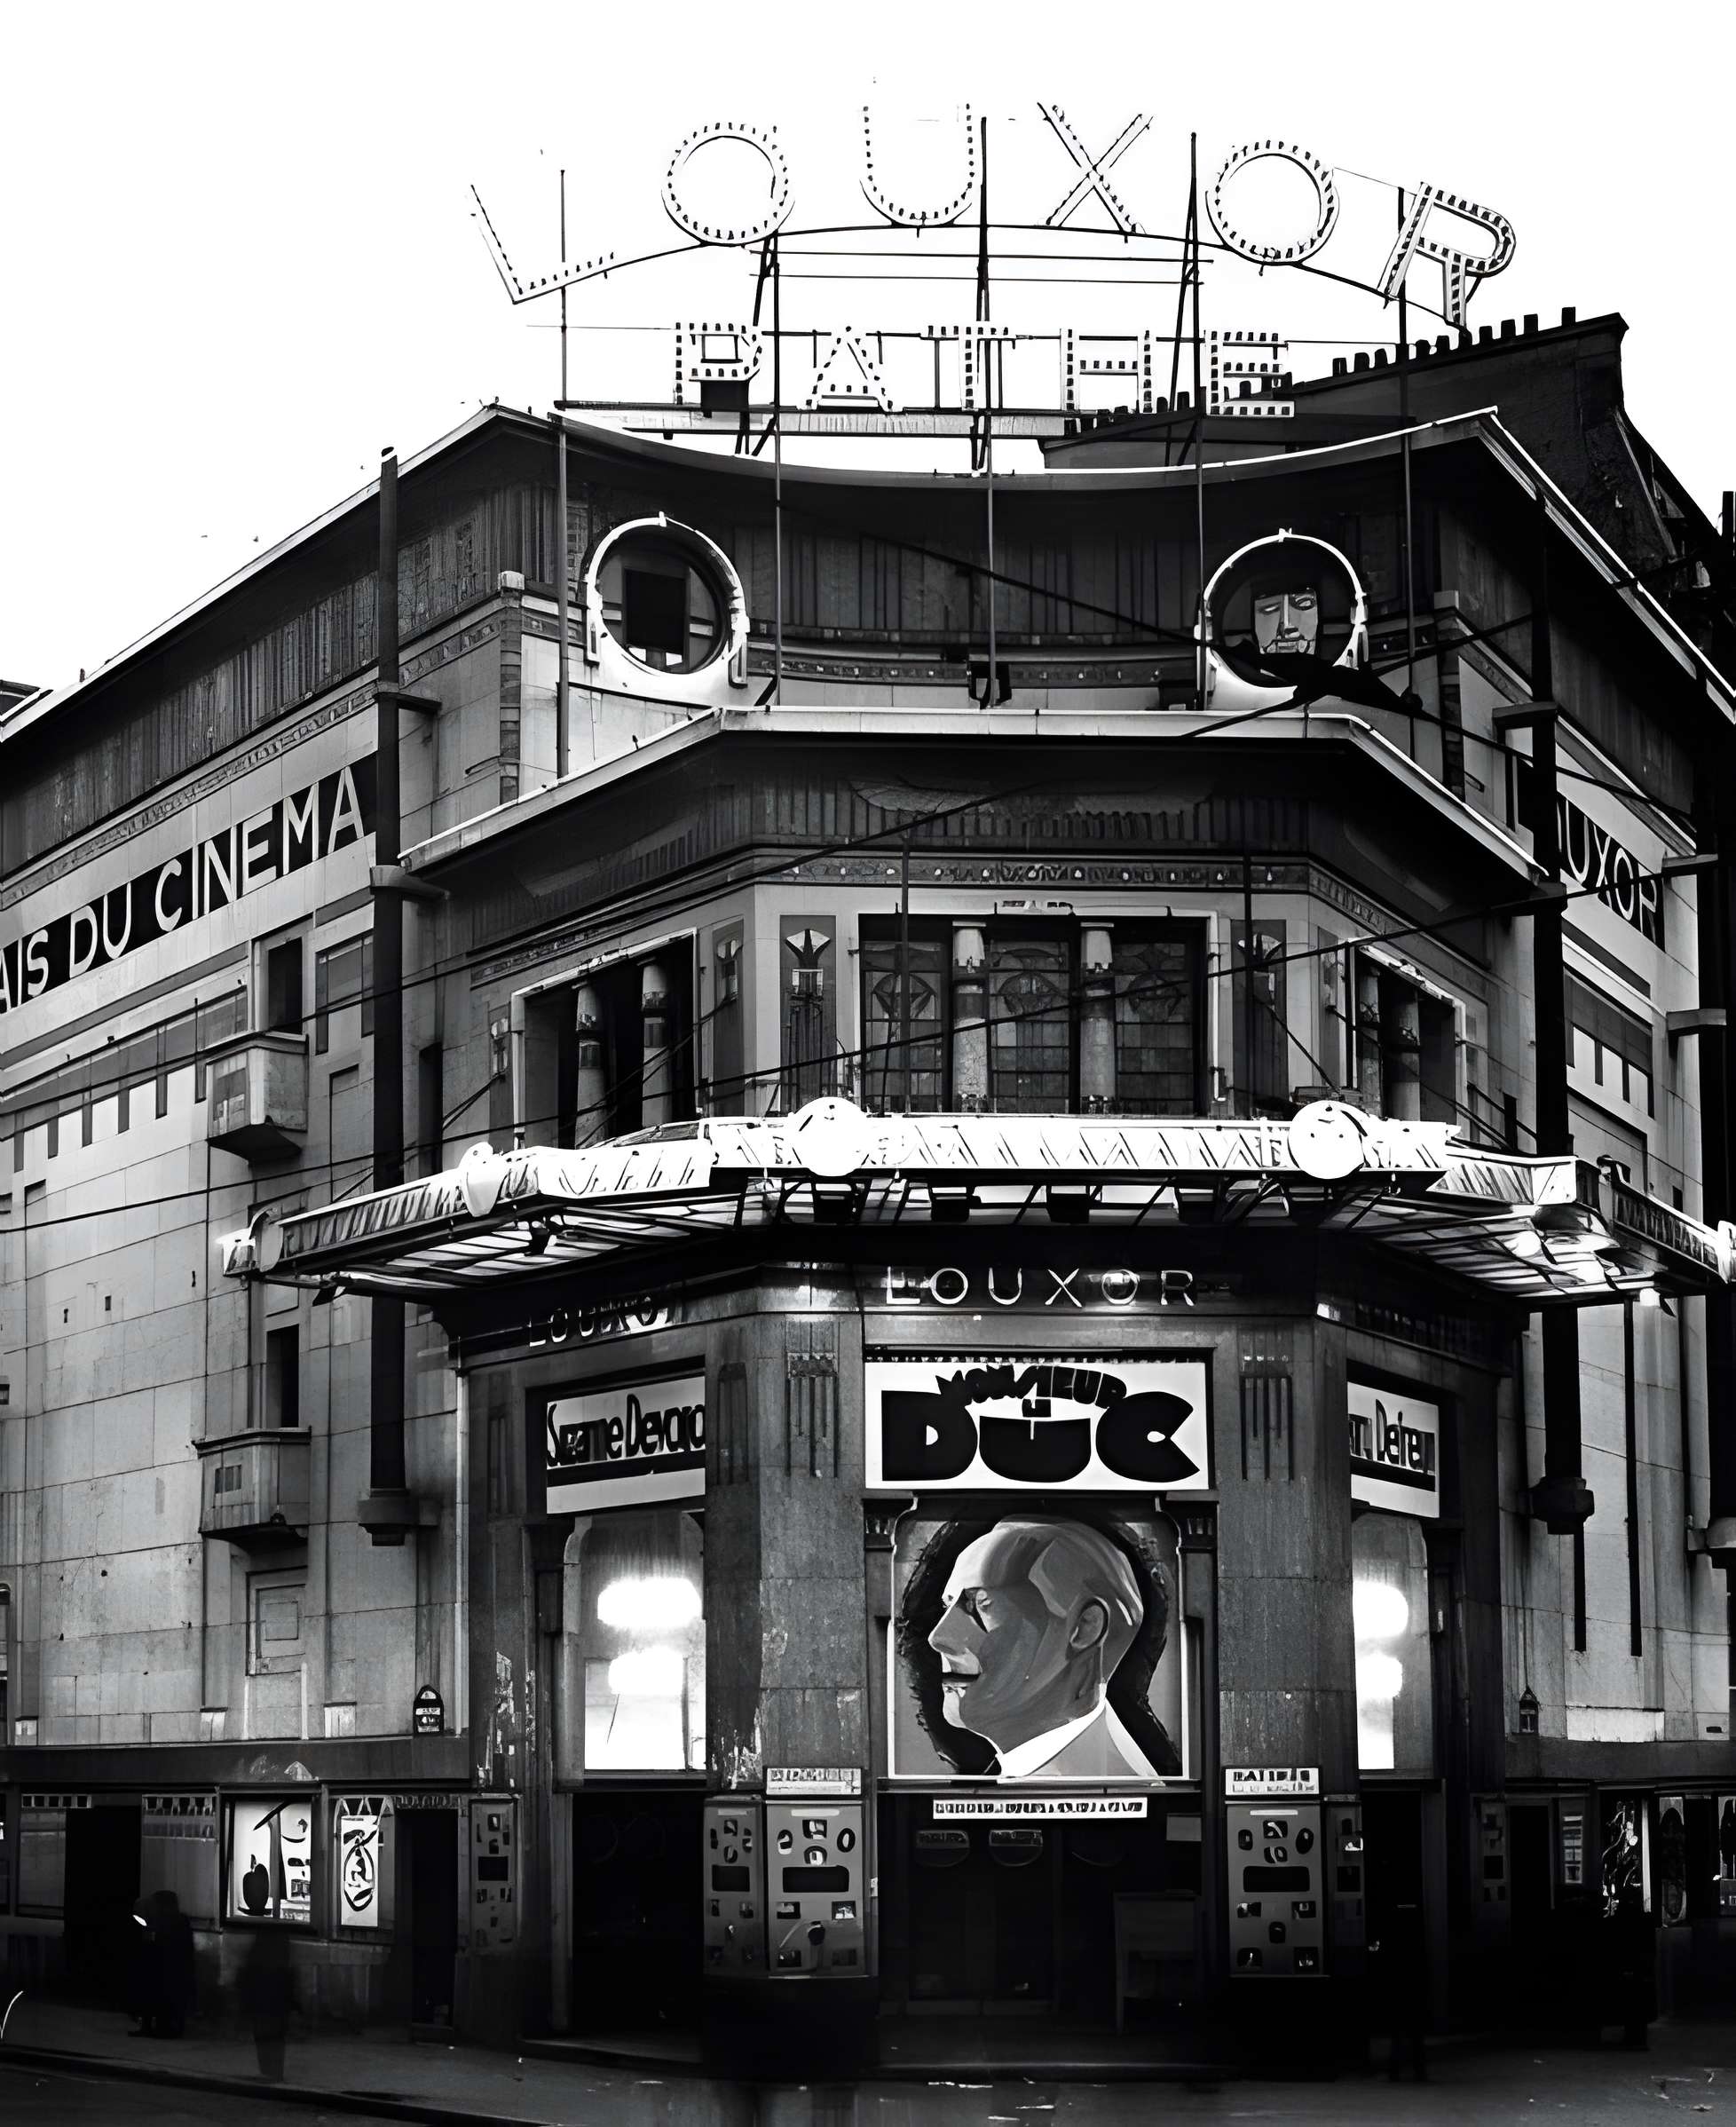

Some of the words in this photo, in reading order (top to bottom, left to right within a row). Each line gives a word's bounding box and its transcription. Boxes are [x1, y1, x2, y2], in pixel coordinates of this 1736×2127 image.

[468, 101, 1517, 325] LOUXOR
[69, 882, 132, 980] DU
[154, 766, 365, 932] CINEMA
[1557, 798, 1657, 943] UXOR
[887, 1265, 1195, 1308] LOUXOR
[881, 1389, 1201, 1483] DUC
